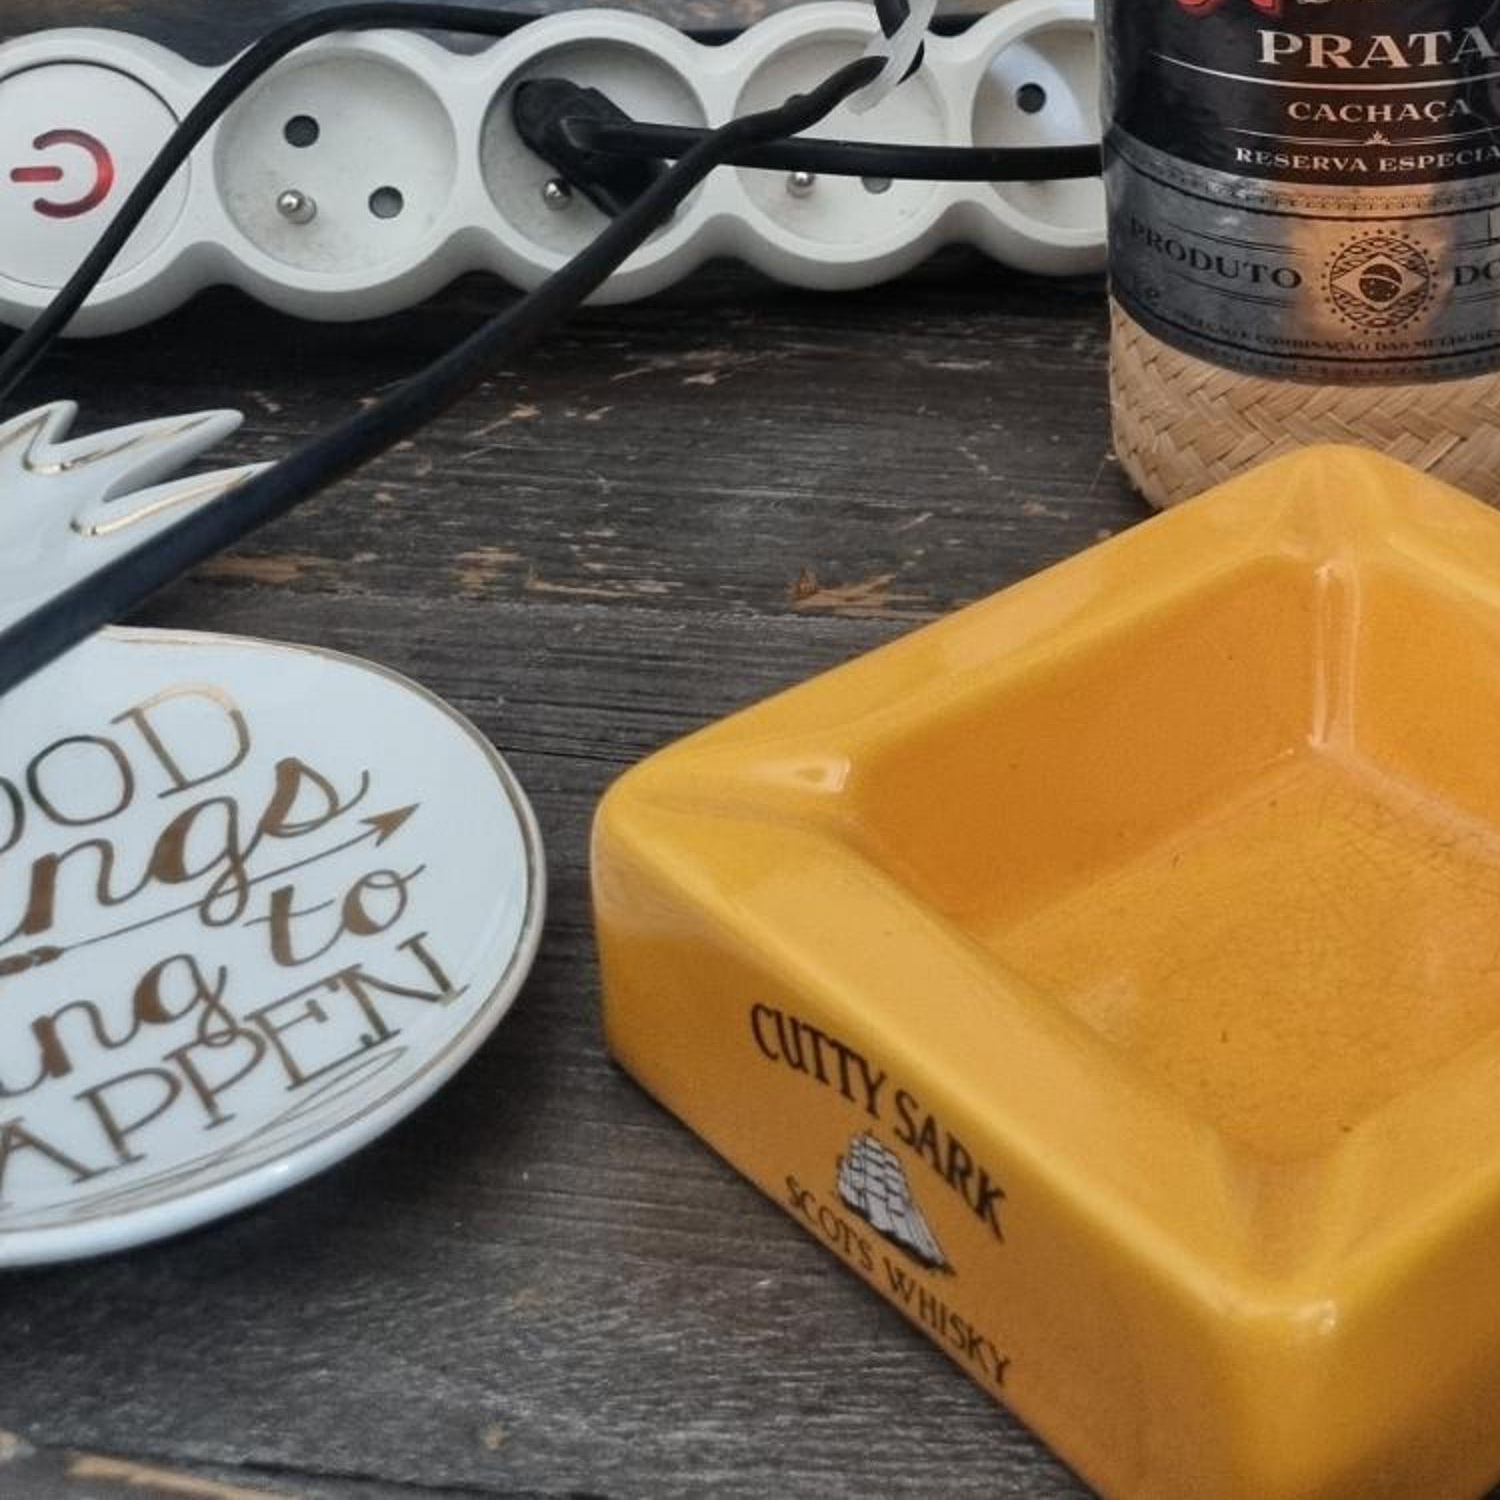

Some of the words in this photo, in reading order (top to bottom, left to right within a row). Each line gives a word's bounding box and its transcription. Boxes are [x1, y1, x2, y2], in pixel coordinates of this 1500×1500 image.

[1257, 27, 1498, 70] PRATA
[1288, 99, 1472, 124] CACHAÇA
[1234, 146, 1369, 174] RESERVA
[1130, 216, 1303, 290] PRODUTO
[244, 863, 427, 967] to
[750, 1002, 887, 1121] CUTTY
[893, 1088, 1008, 1243] SARK
[785, 1173, 876, 1274] SCOTS
[883, 1256, 1011, 1386] WHISKY
